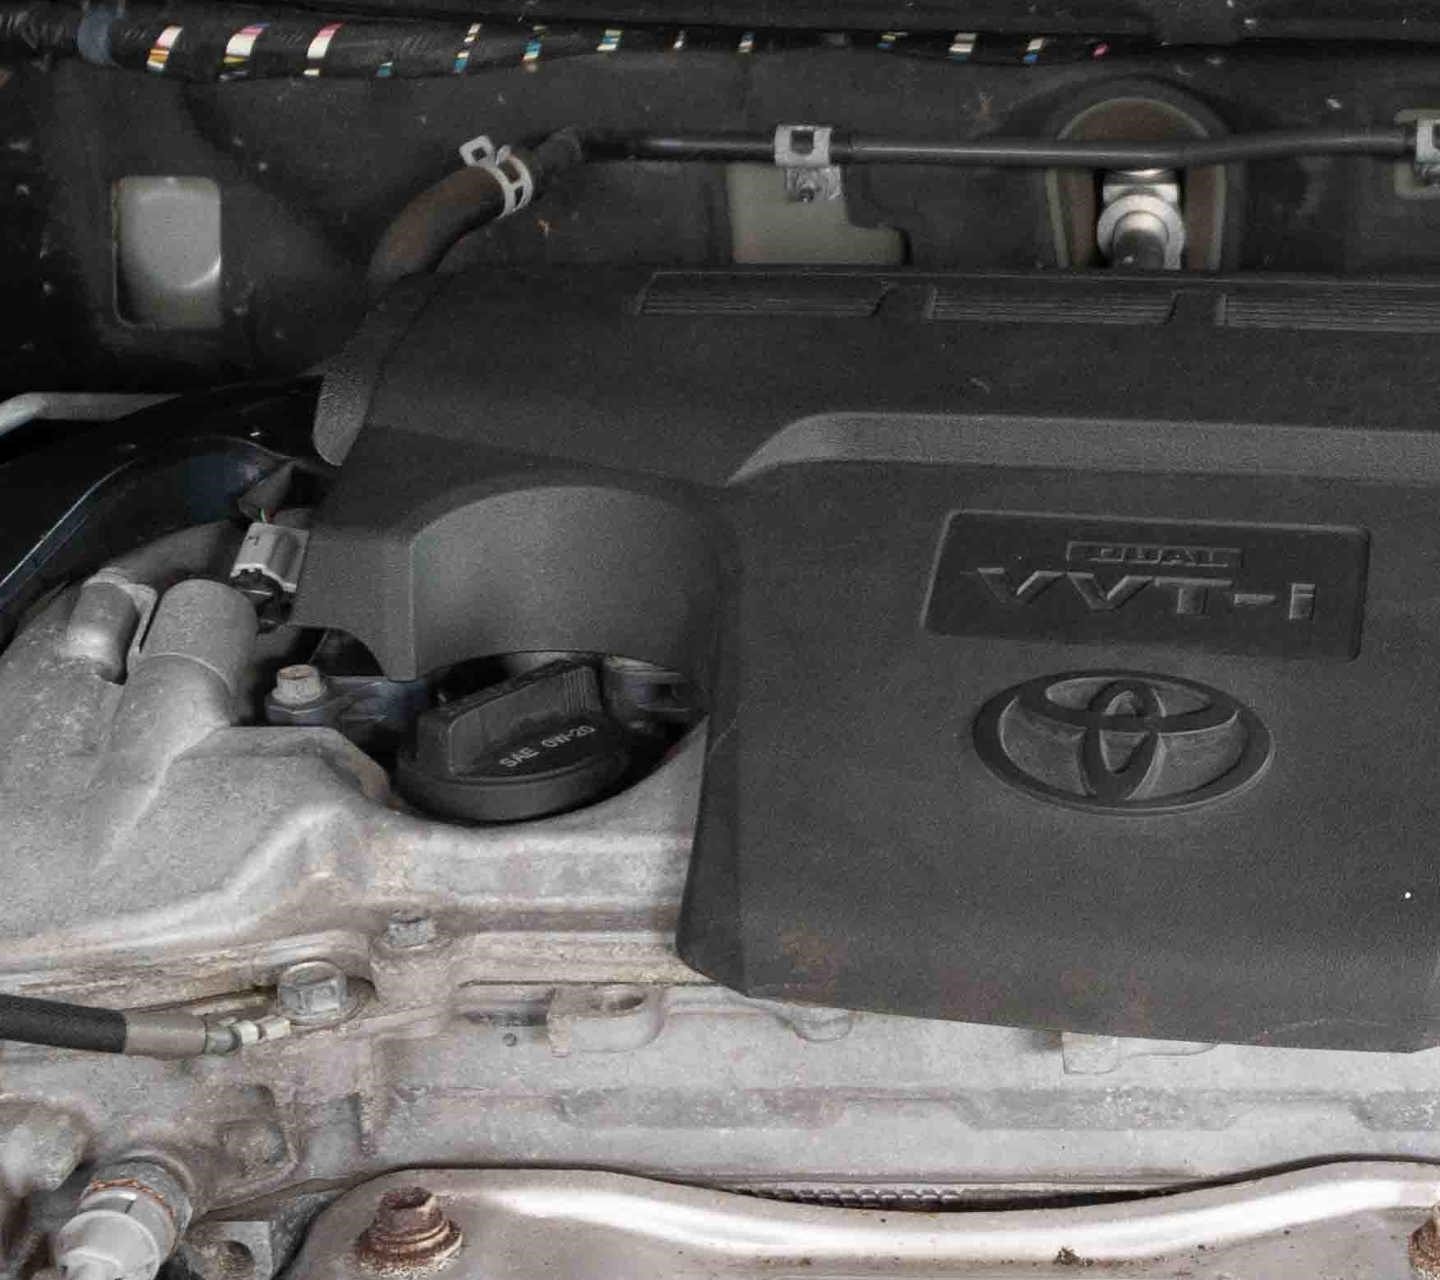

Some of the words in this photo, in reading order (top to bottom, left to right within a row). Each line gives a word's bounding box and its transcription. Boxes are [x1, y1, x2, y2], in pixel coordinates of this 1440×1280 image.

[977, 567, 1317, 620] VVT-i
[499, 746, 540, 769] SAE
[541, 724, 596, 751] 0W-20
